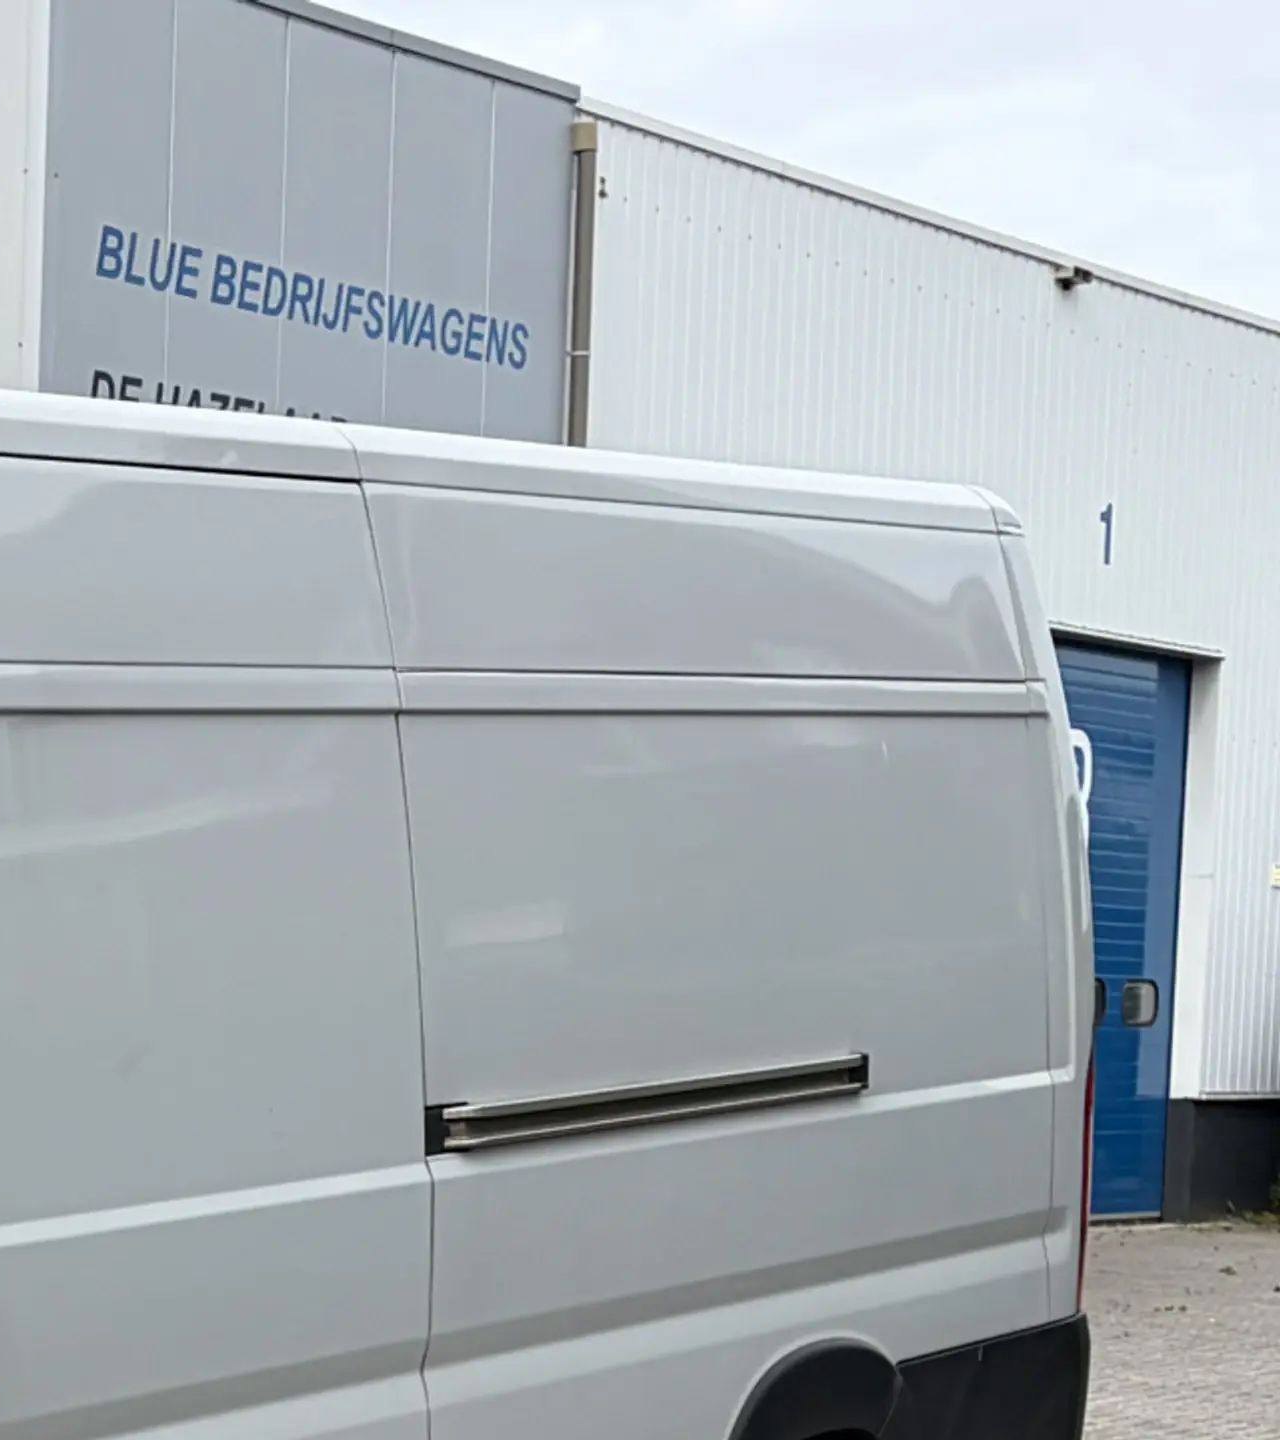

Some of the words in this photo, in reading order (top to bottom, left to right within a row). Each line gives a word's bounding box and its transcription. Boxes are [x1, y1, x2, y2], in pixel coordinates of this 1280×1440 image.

[96, 225, 203, 299] BLUE
[210, 254, 529, 370] BEDRIJFSWAGENS
[1100, 502, 1113, 565] 1
